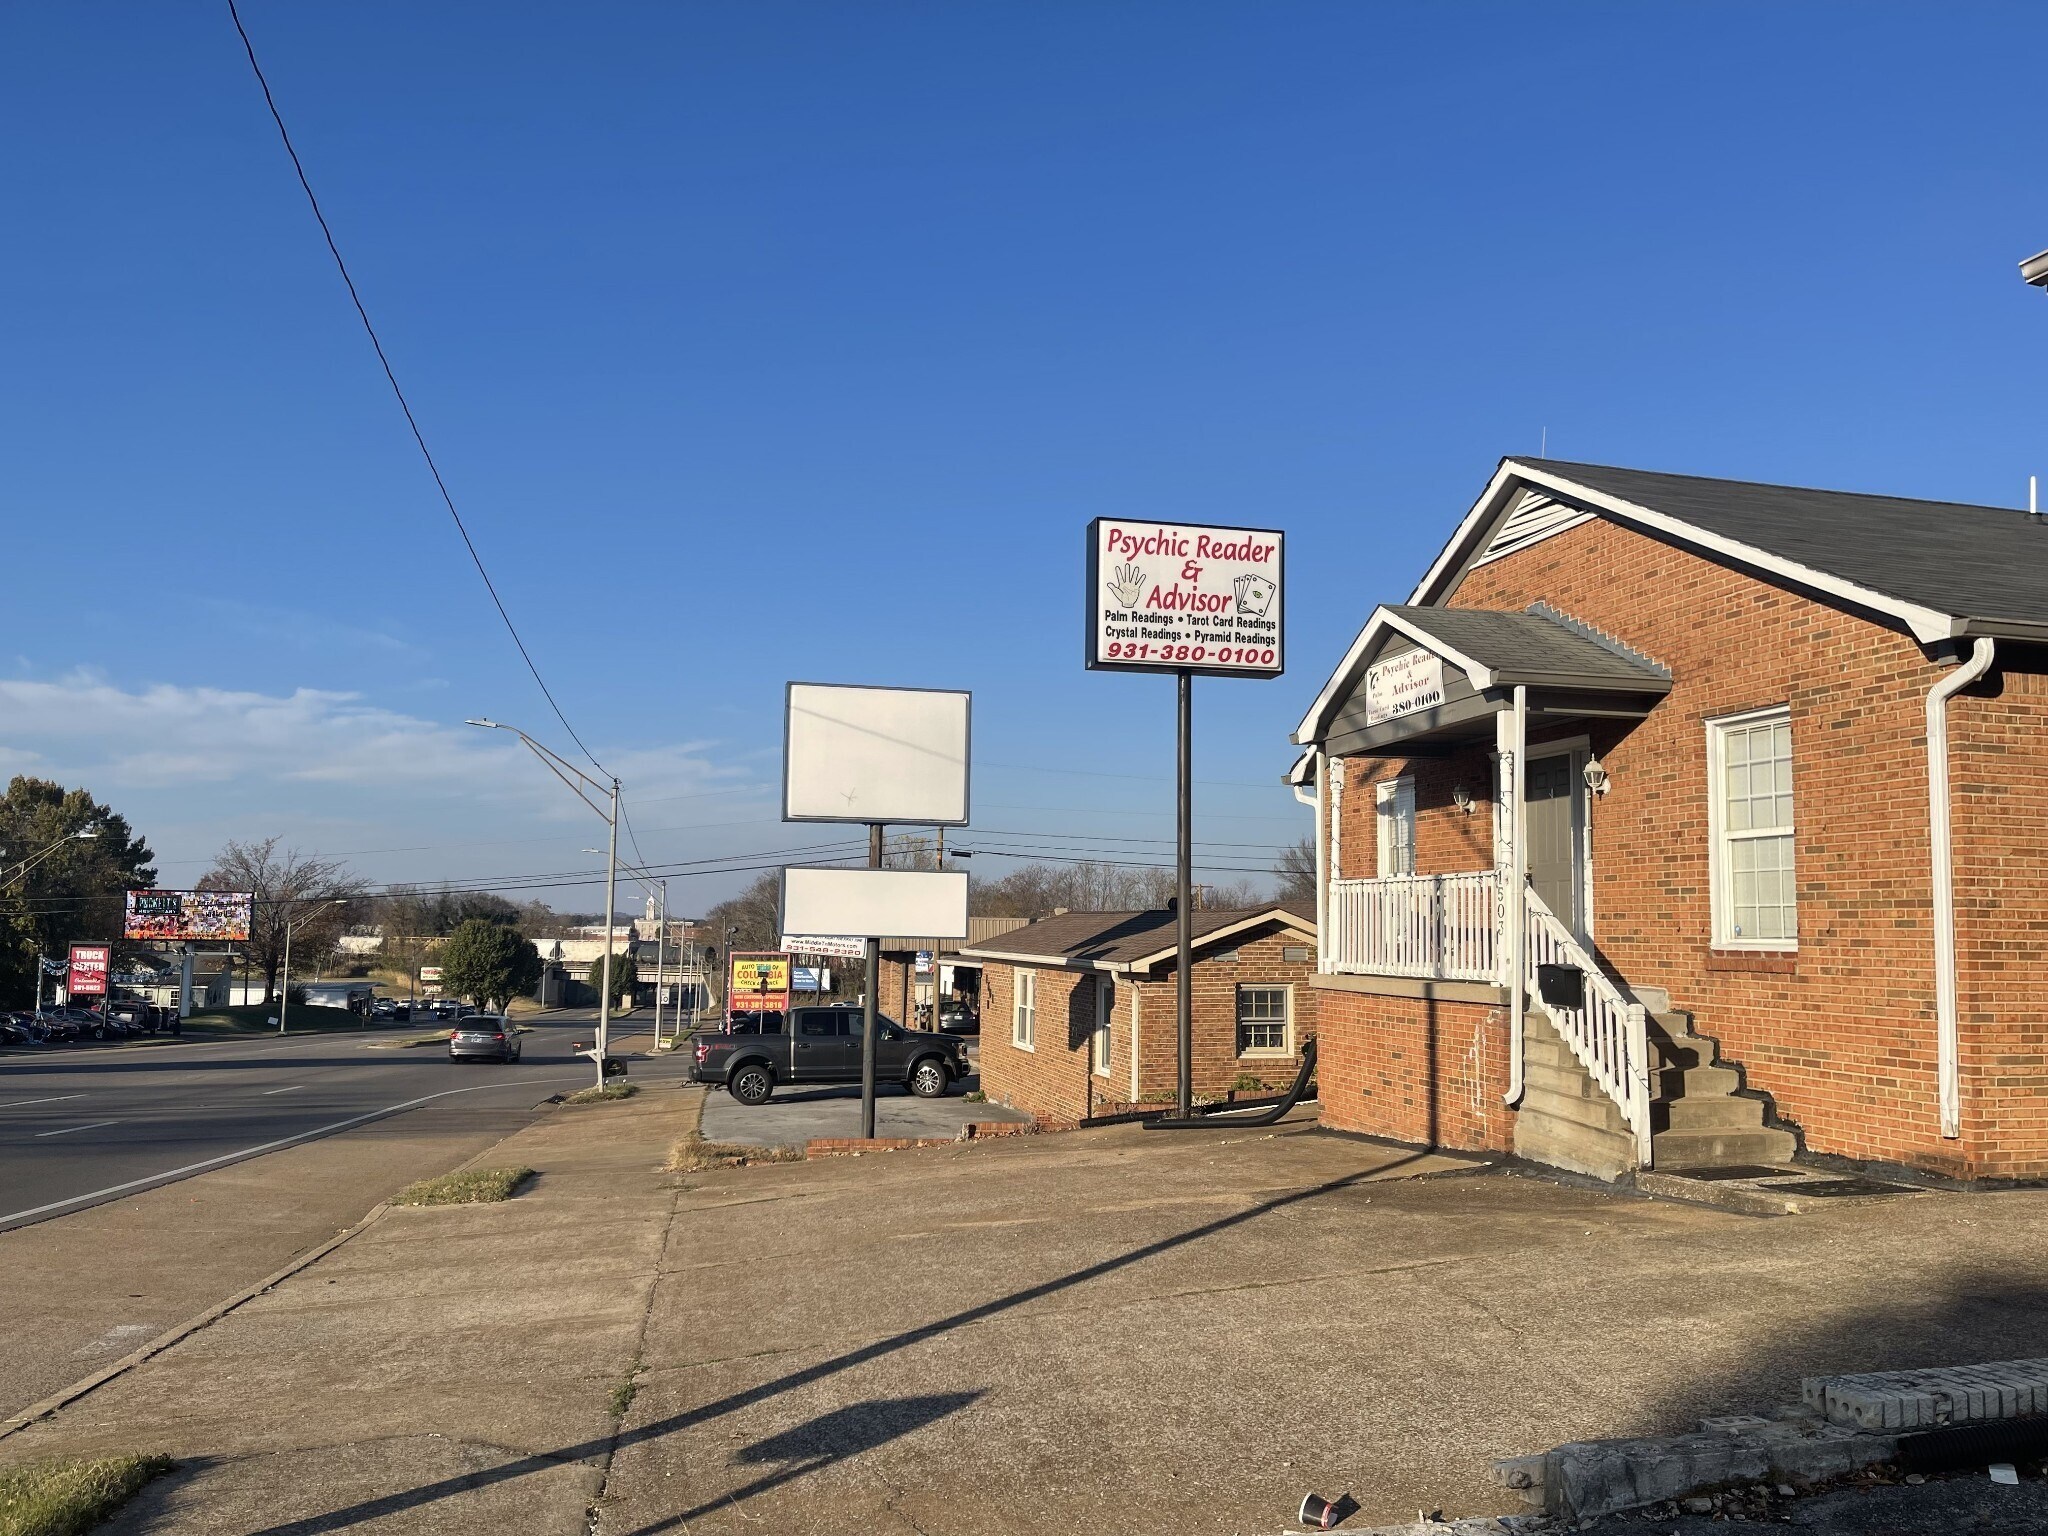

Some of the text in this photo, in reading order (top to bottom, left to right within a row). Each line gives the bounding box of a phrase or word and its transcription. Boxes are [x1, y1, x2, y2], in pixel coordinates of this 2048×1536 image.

[1107, 528, 1275, 563] Psychic Reader
[1181, 559, 1204, 582] &
[1145, 582, 1233, 613] Advisor
[1104, 610, 1276, 630] Palm Readings Tarot Card Readings
[1105, 625, 1276, 647] Crystal Readings Pyramid Readings
[1107, 642, 1275, 665] 931-380-0100
[1382, 660, 1410, 677] Psychic
[1391, 677, 1430, 697] Advisor
[1392, 690, 1440, 715] 380-0100
[75, 950, 105, 960] TRUCK
[73, 962, 105, 971] CENTER
[737, 970, 783, 979] COLUBIA
